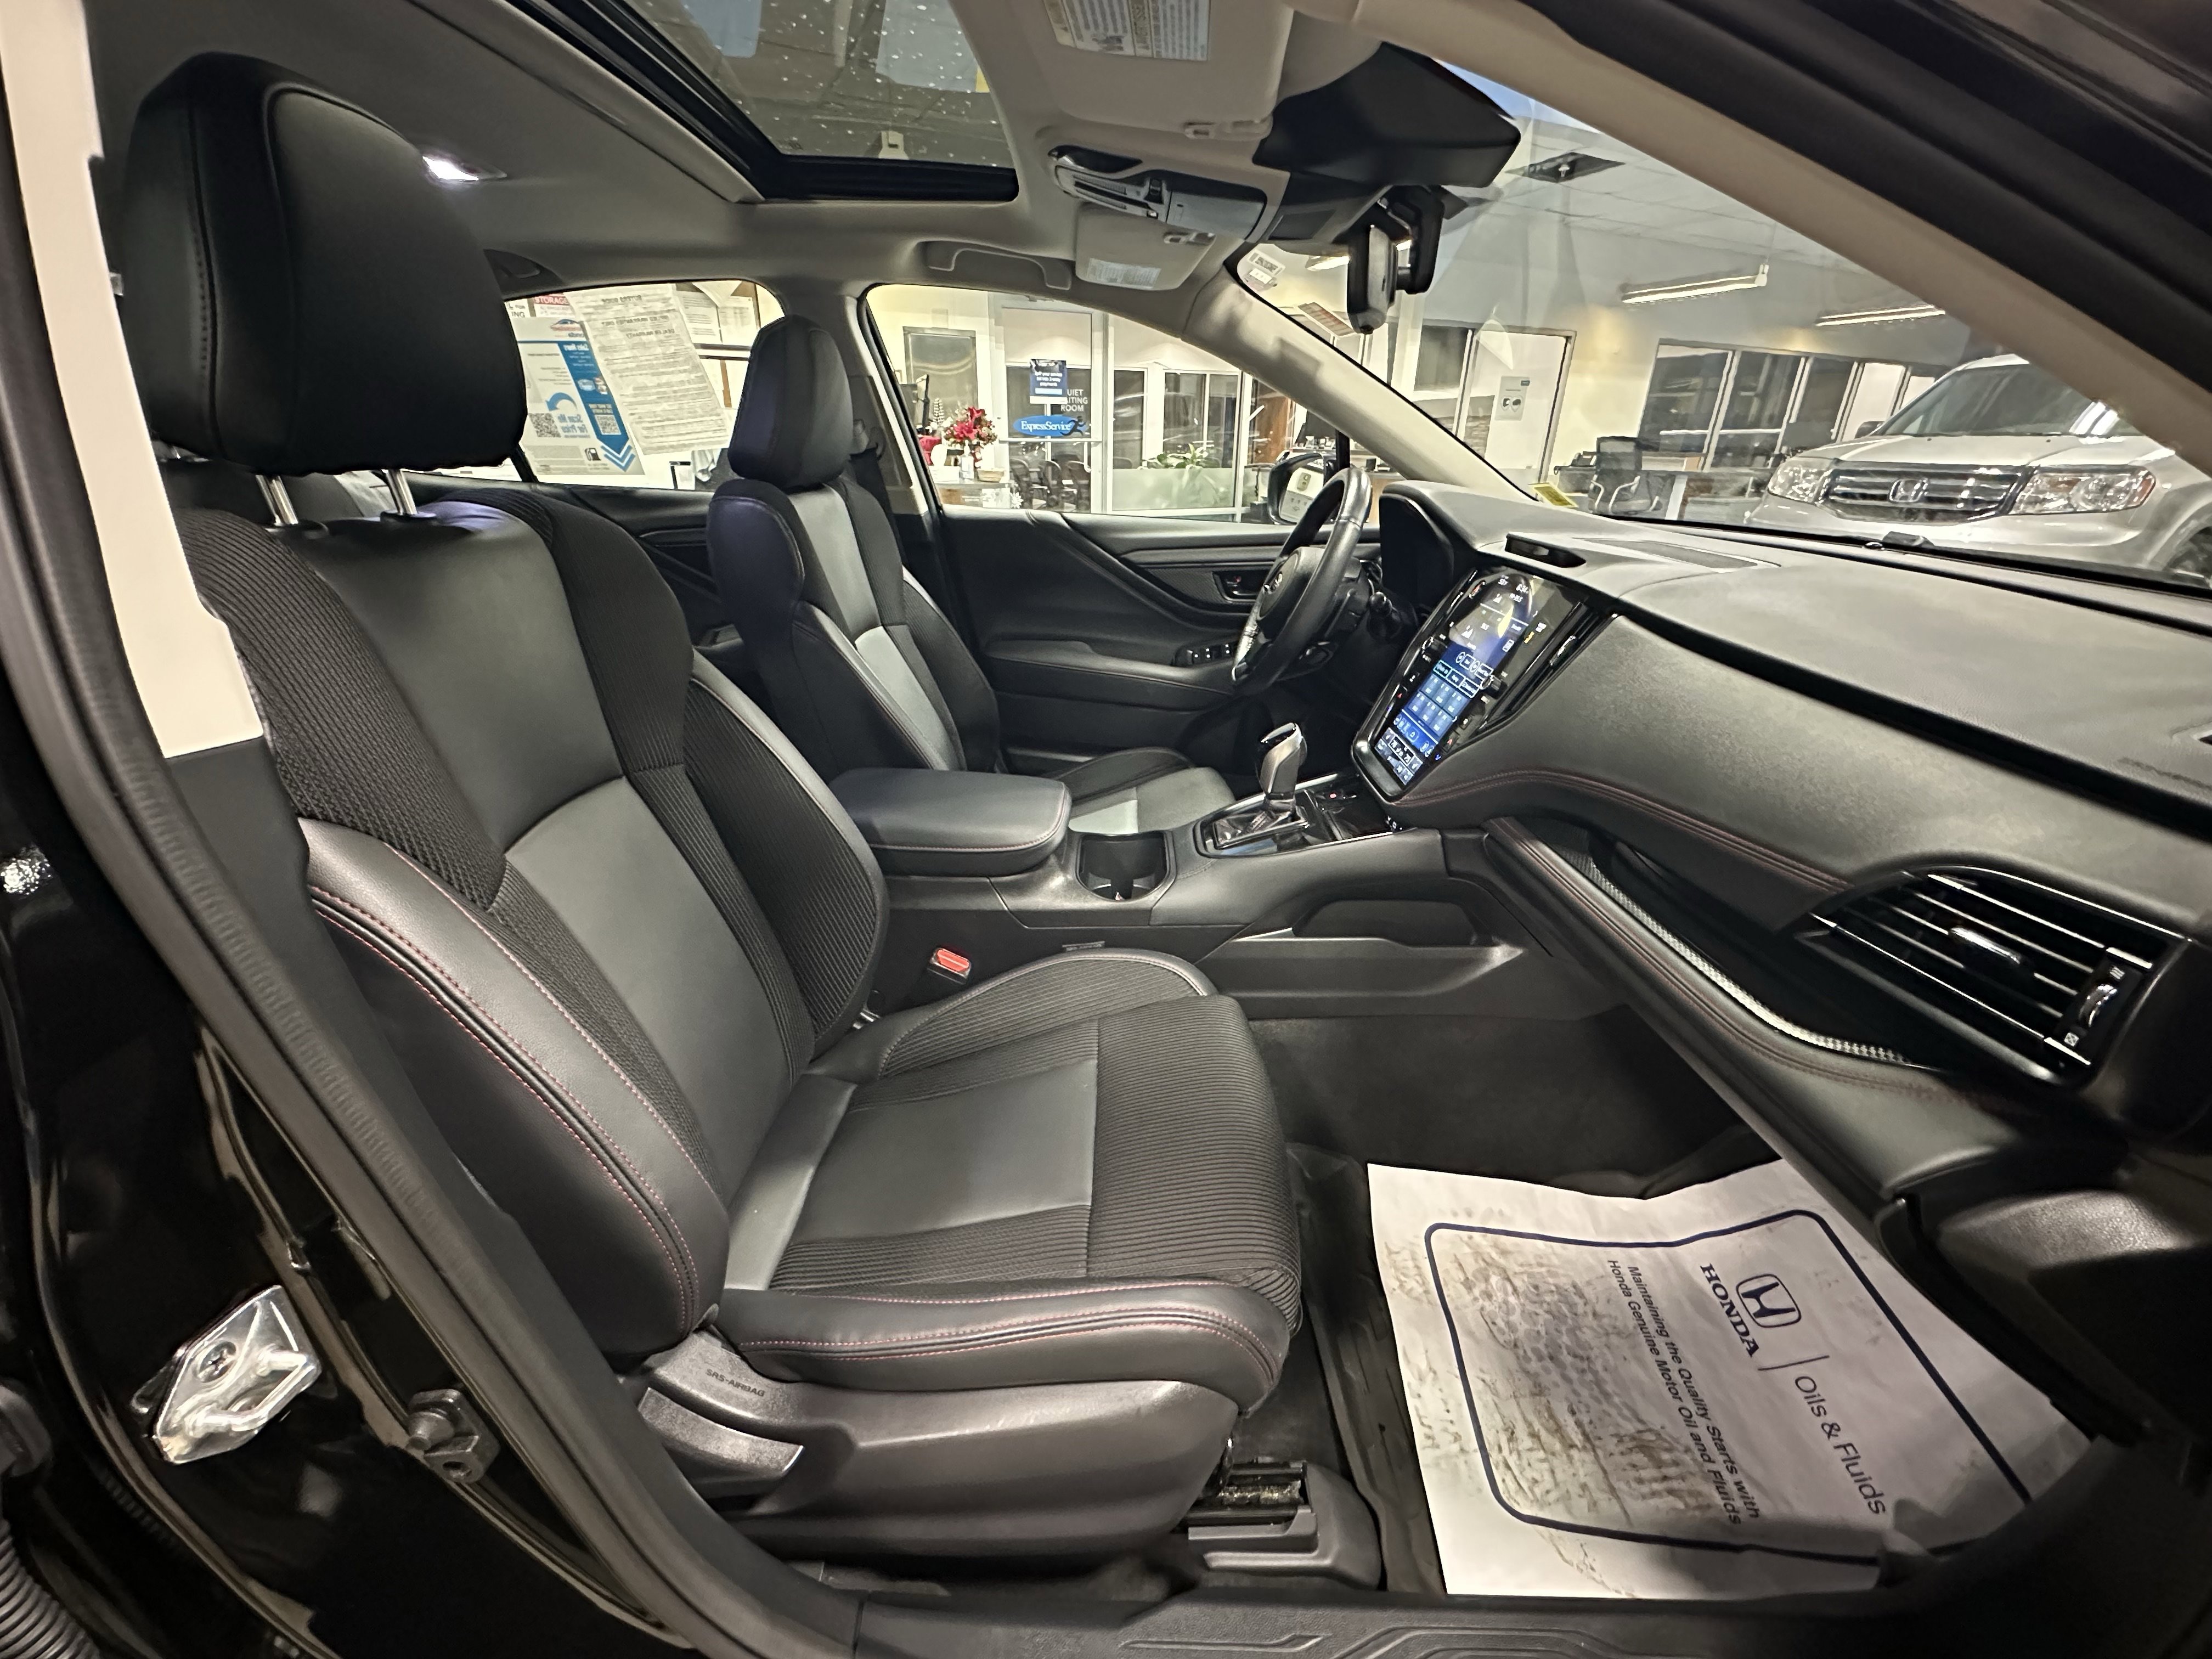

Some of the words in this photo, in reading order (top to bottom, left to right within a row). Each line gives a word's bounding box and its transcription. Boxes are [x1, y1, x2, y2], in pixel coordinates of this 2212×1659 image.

[1021, 420, 1071, 432] ExpressService
[1700, 1263, 1759, 1358] HONDA
[706, 1368, 766, 1397] SRS-AIRBAG
[1607, 1260, 1632, 1297] Honda
[1628, 1301, 1660, 1356] Genuine
[1655, 1359, 1683, 1403] Motor
[1678, 1406, 1699, 1429] Oil
[1690, 1432, 1716, 1464] and
[1707, 1469, 1741, 1525] Fluids
[1628, 1266, 1669, 1338] Maintaining
[1665, 1342, 1682, 1364] the
[1678, 1368, 1711, 1421] Quality
[1706, 1425, 1738, 1475] Starts
[1734, 1480, 1760, 1518] with
[1795, 1376, 1827, 1418] Oils
[1821, 1422, 1841, 1440] &
[1833, 1443, 1886, 1515] Fluids
